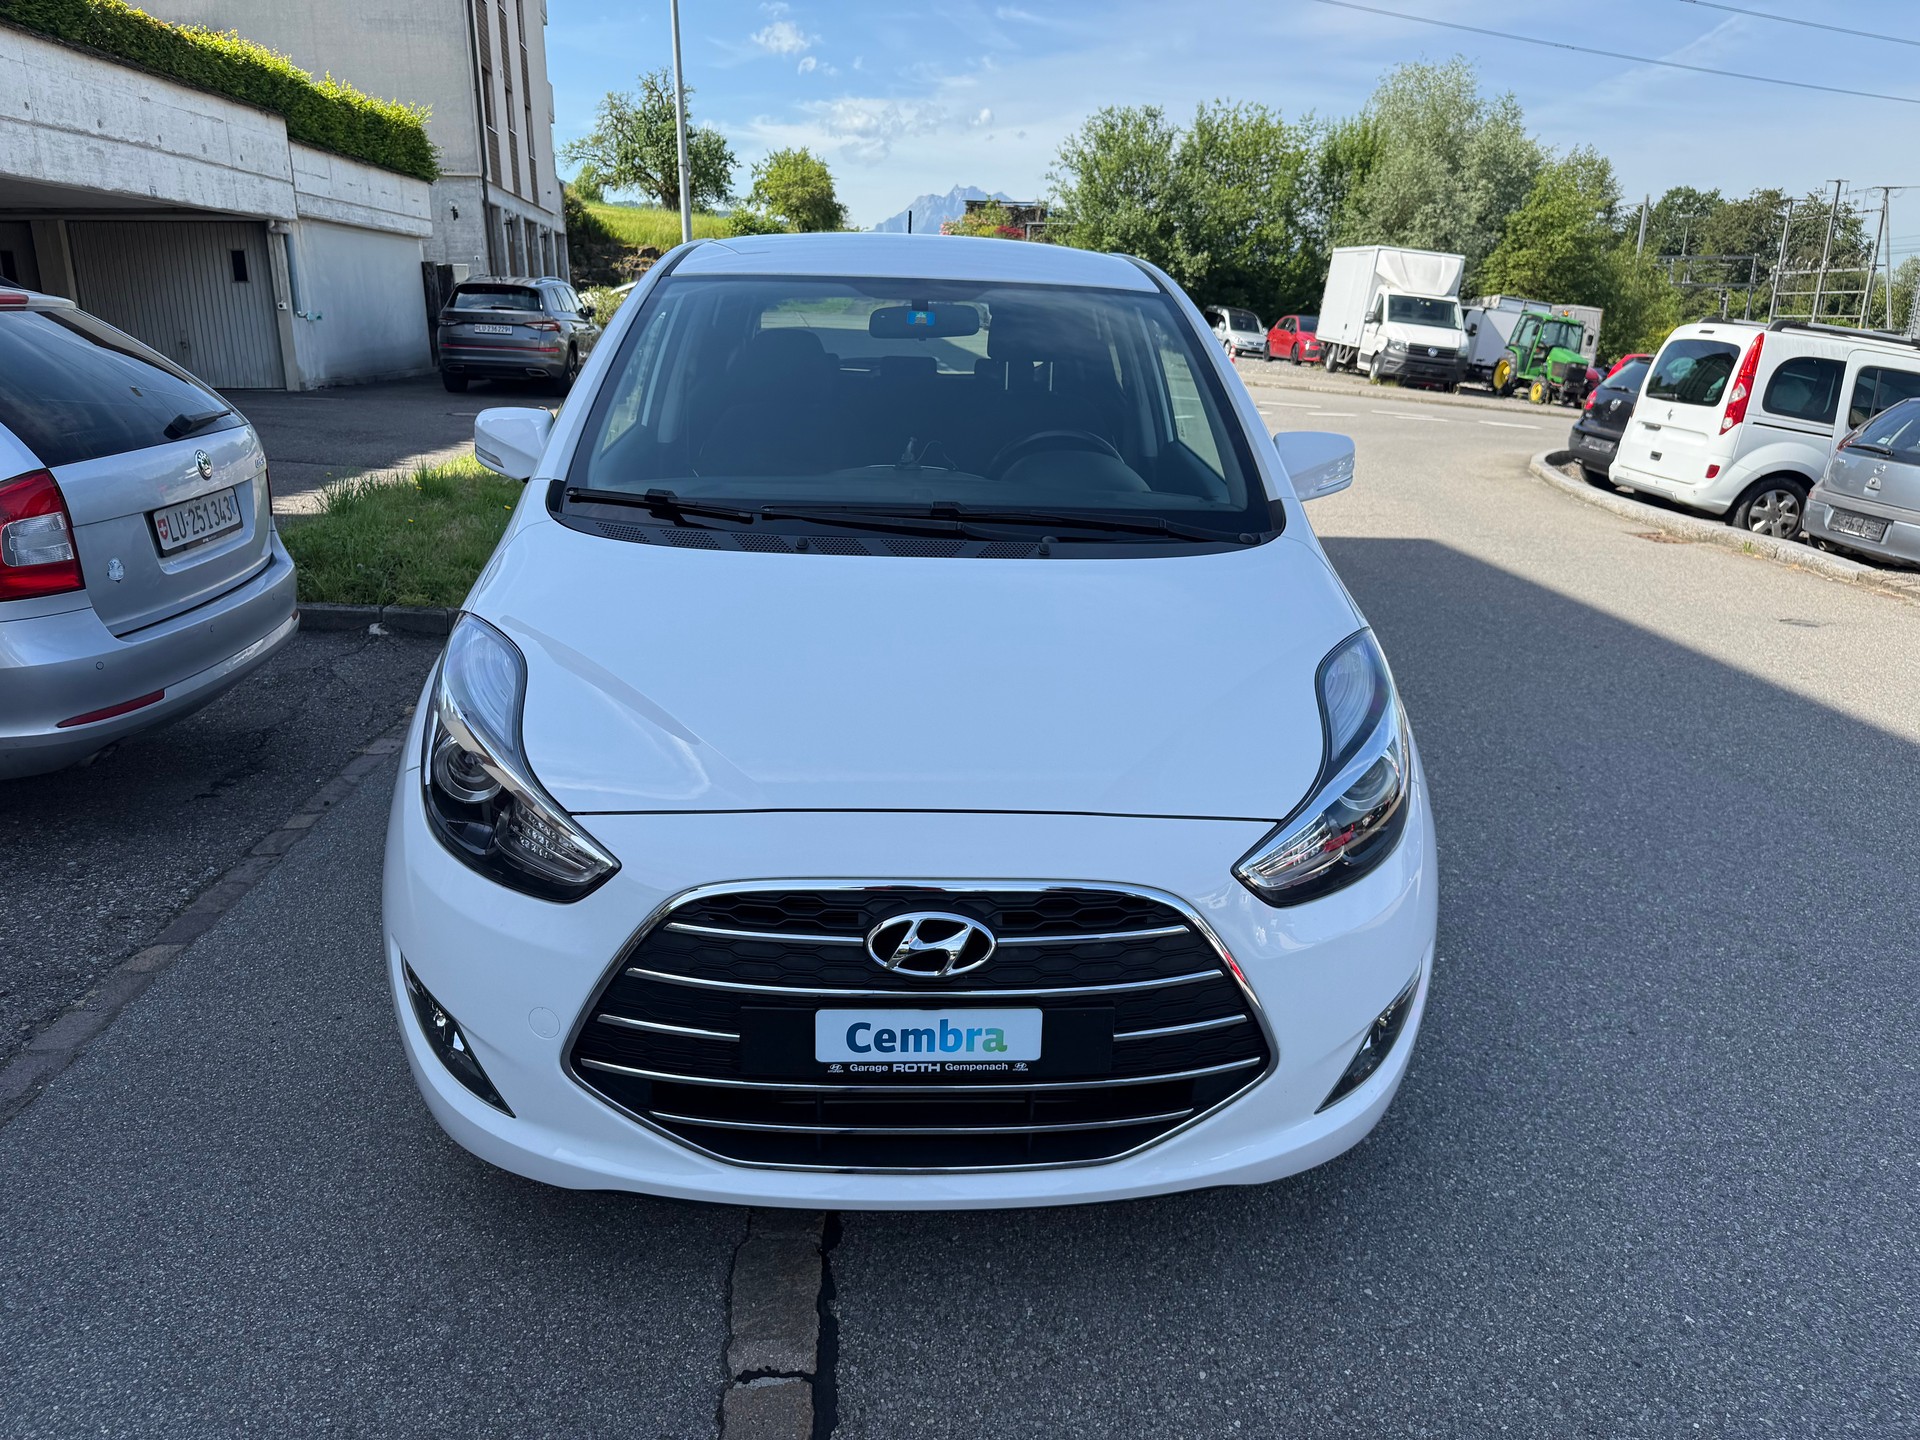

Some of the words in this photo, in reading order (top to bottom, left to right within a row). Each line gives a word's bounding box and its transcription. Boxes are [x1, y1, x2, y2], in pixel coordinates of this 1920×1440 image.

[846, 1019, 1008, 1053] Cembra
[849, 1063, 889, 1073] Garage
[892, 1063, 941, 1073] ROTH
[944, 1062, 1009, 1072] Gempenach
